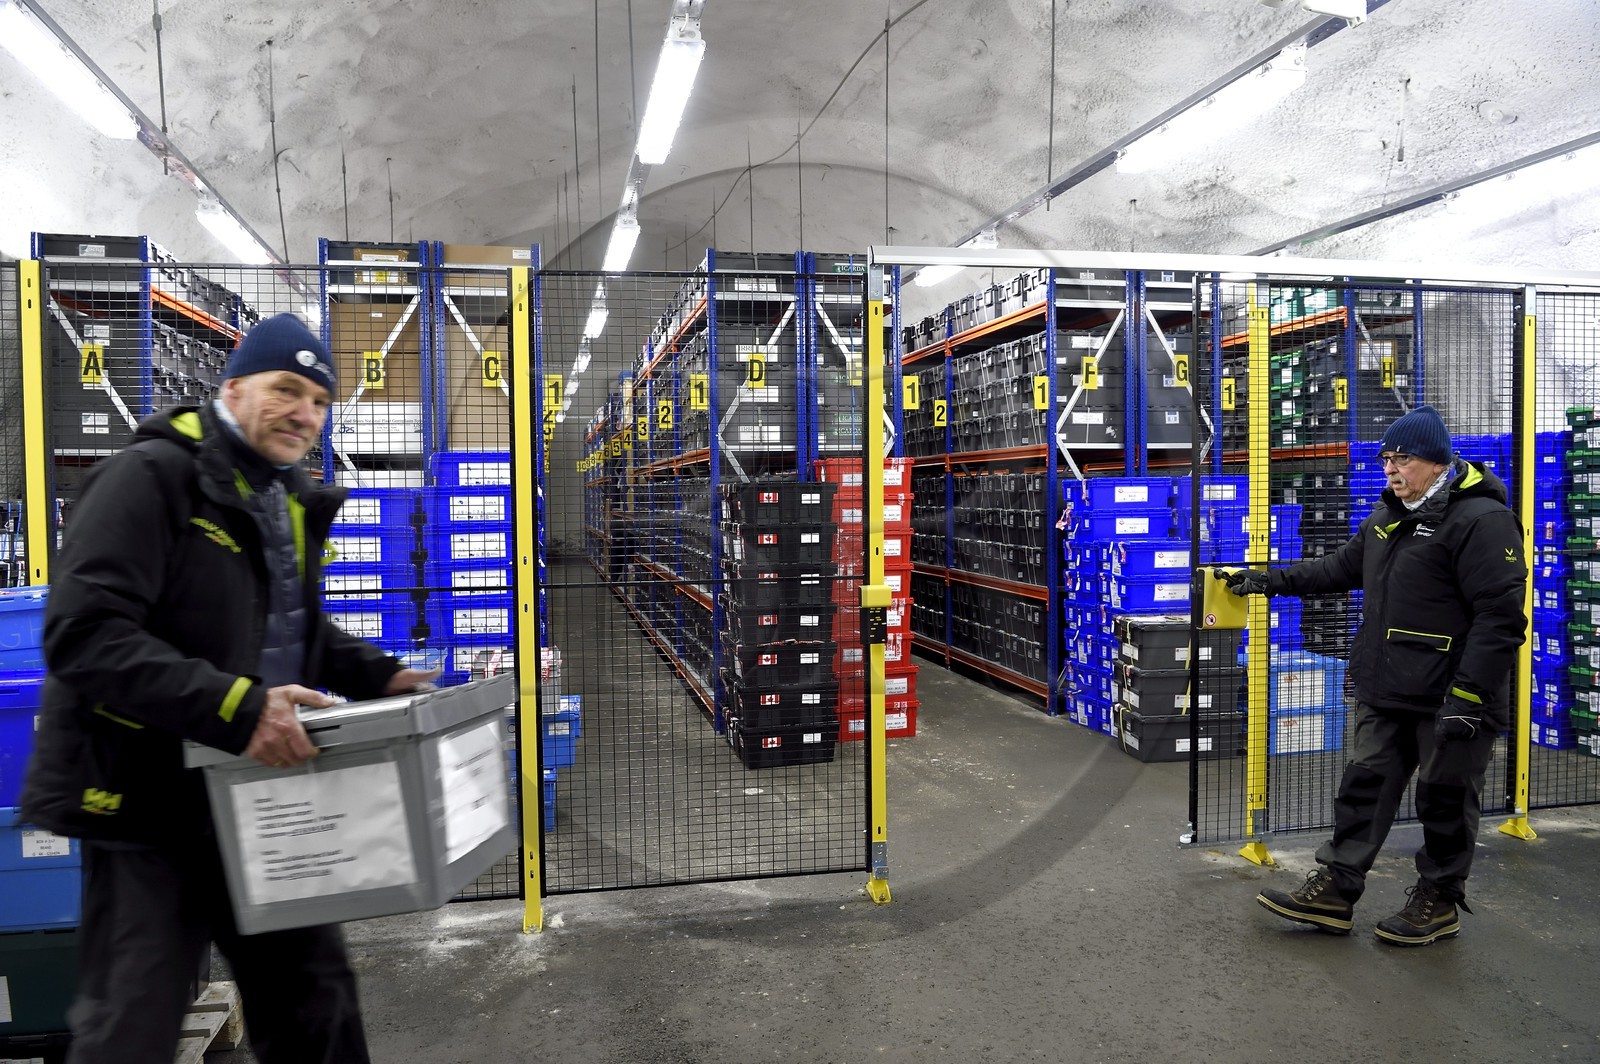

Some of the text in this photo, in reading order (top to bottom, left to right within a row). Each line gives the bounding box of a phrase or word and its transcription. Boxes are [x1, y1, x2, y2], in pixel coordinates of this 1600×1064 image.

[83, 351, 102, 376] A
[366, 358, 382, 383] B
[484, 356, 500, 381] C
[750, 359, 764, 382] D
[1085, 363, 1096, 384] F
[1176, 359, 1188, 382] G
[1383, 361, 1393, 382] H
[549, 381, 560, 405] 1
[695, 381, 705, 404] 1
[906, 382, 916, 404] 1
[1037, 382, 1046, 404] 1
[1225, 384, 1232, 405] 1
[1337, 384, 1346, 404] 1
[660, 405, 671, 424] 2
[936, 405, 945, 422] 2
[639, 421, 647, 436] 3
[613, 441, 620, 453] 5
[623, 433, 631, 446] 4
[597, 452, 603, 461] 7
[604, 447, 610, 457] 6
[578, 462, 587, 470] 10
